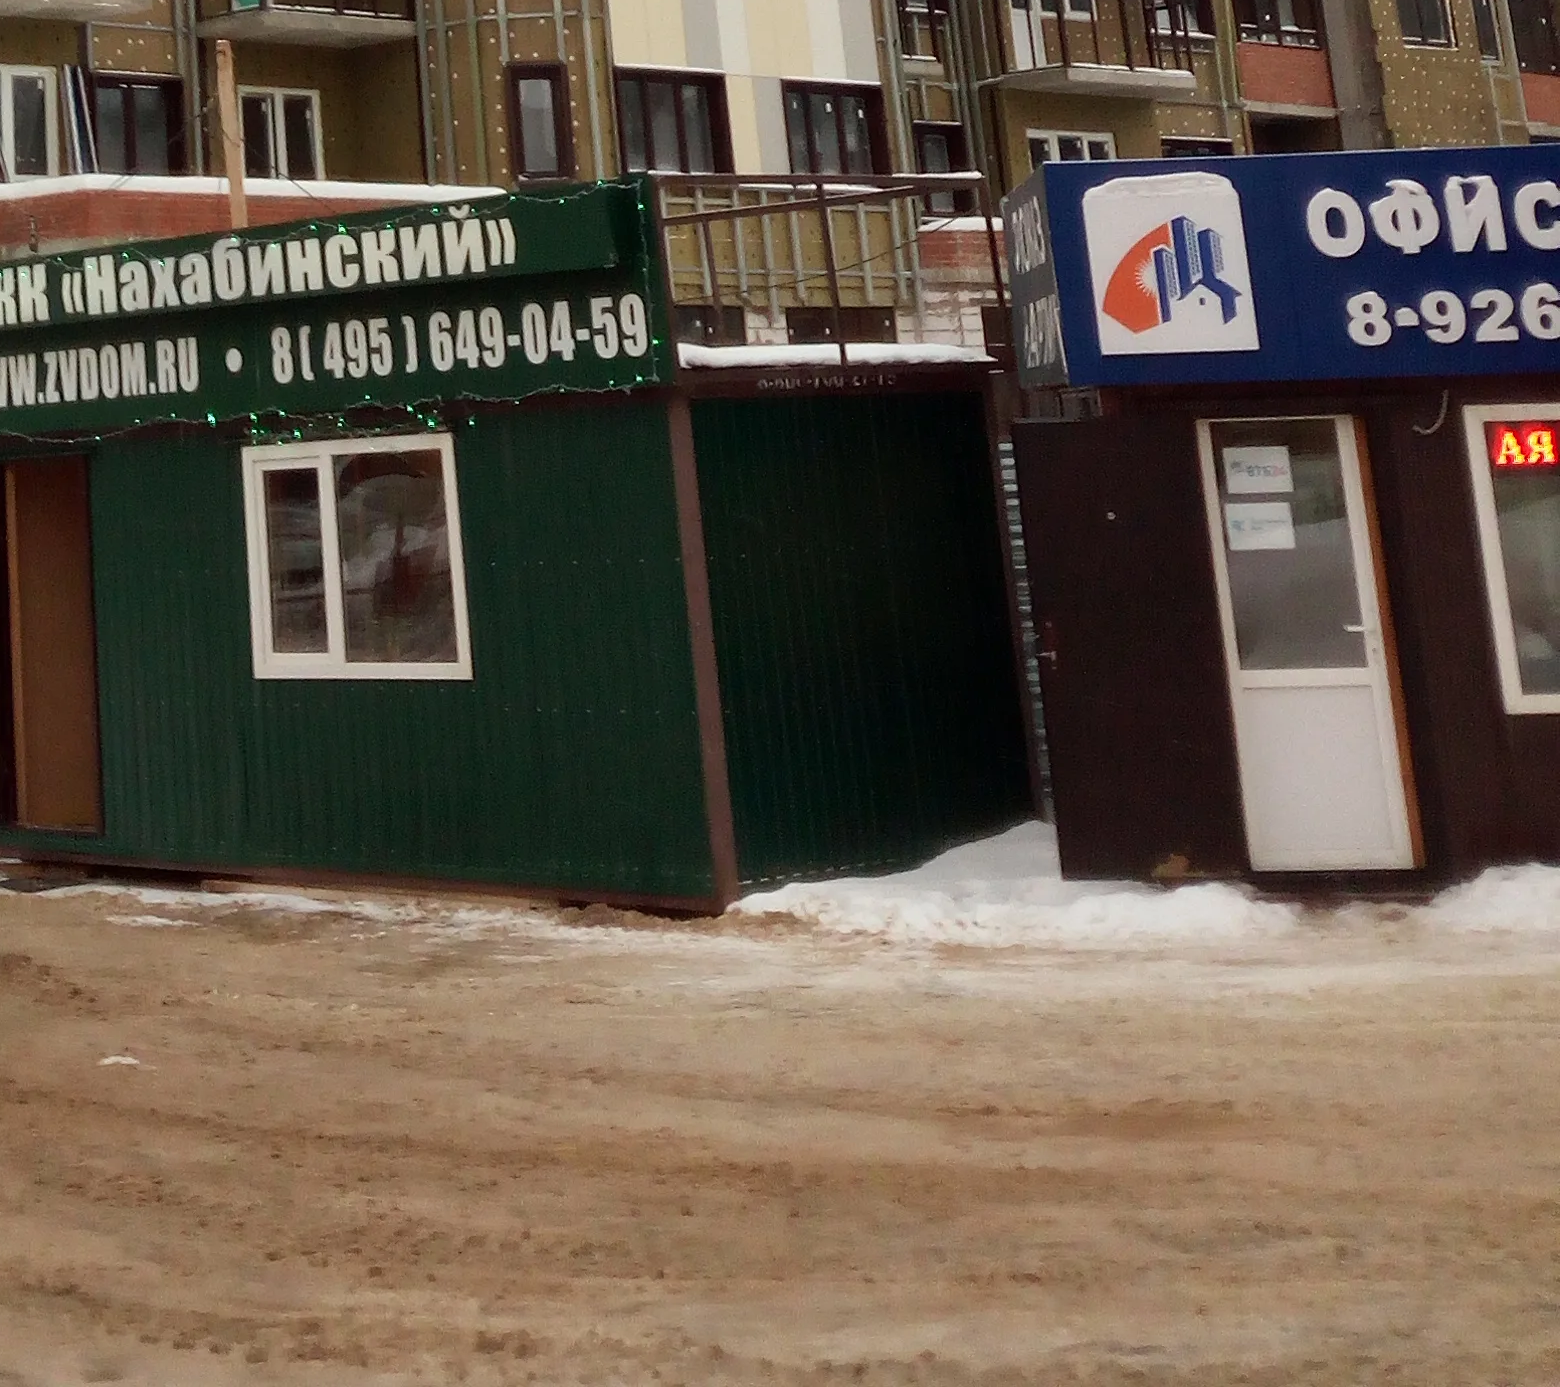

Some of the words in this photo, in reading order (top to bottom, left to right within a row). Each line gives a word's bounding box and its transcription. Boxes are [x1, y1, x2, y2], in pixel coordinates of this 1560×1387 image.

[61, 203, 516, 316] «Нахабинский»
[428, 293, 649, 373] 649-04-59
[1346, 282, 1560, 346] 8-926
[1495, 429, 1555, 466] АЯ
